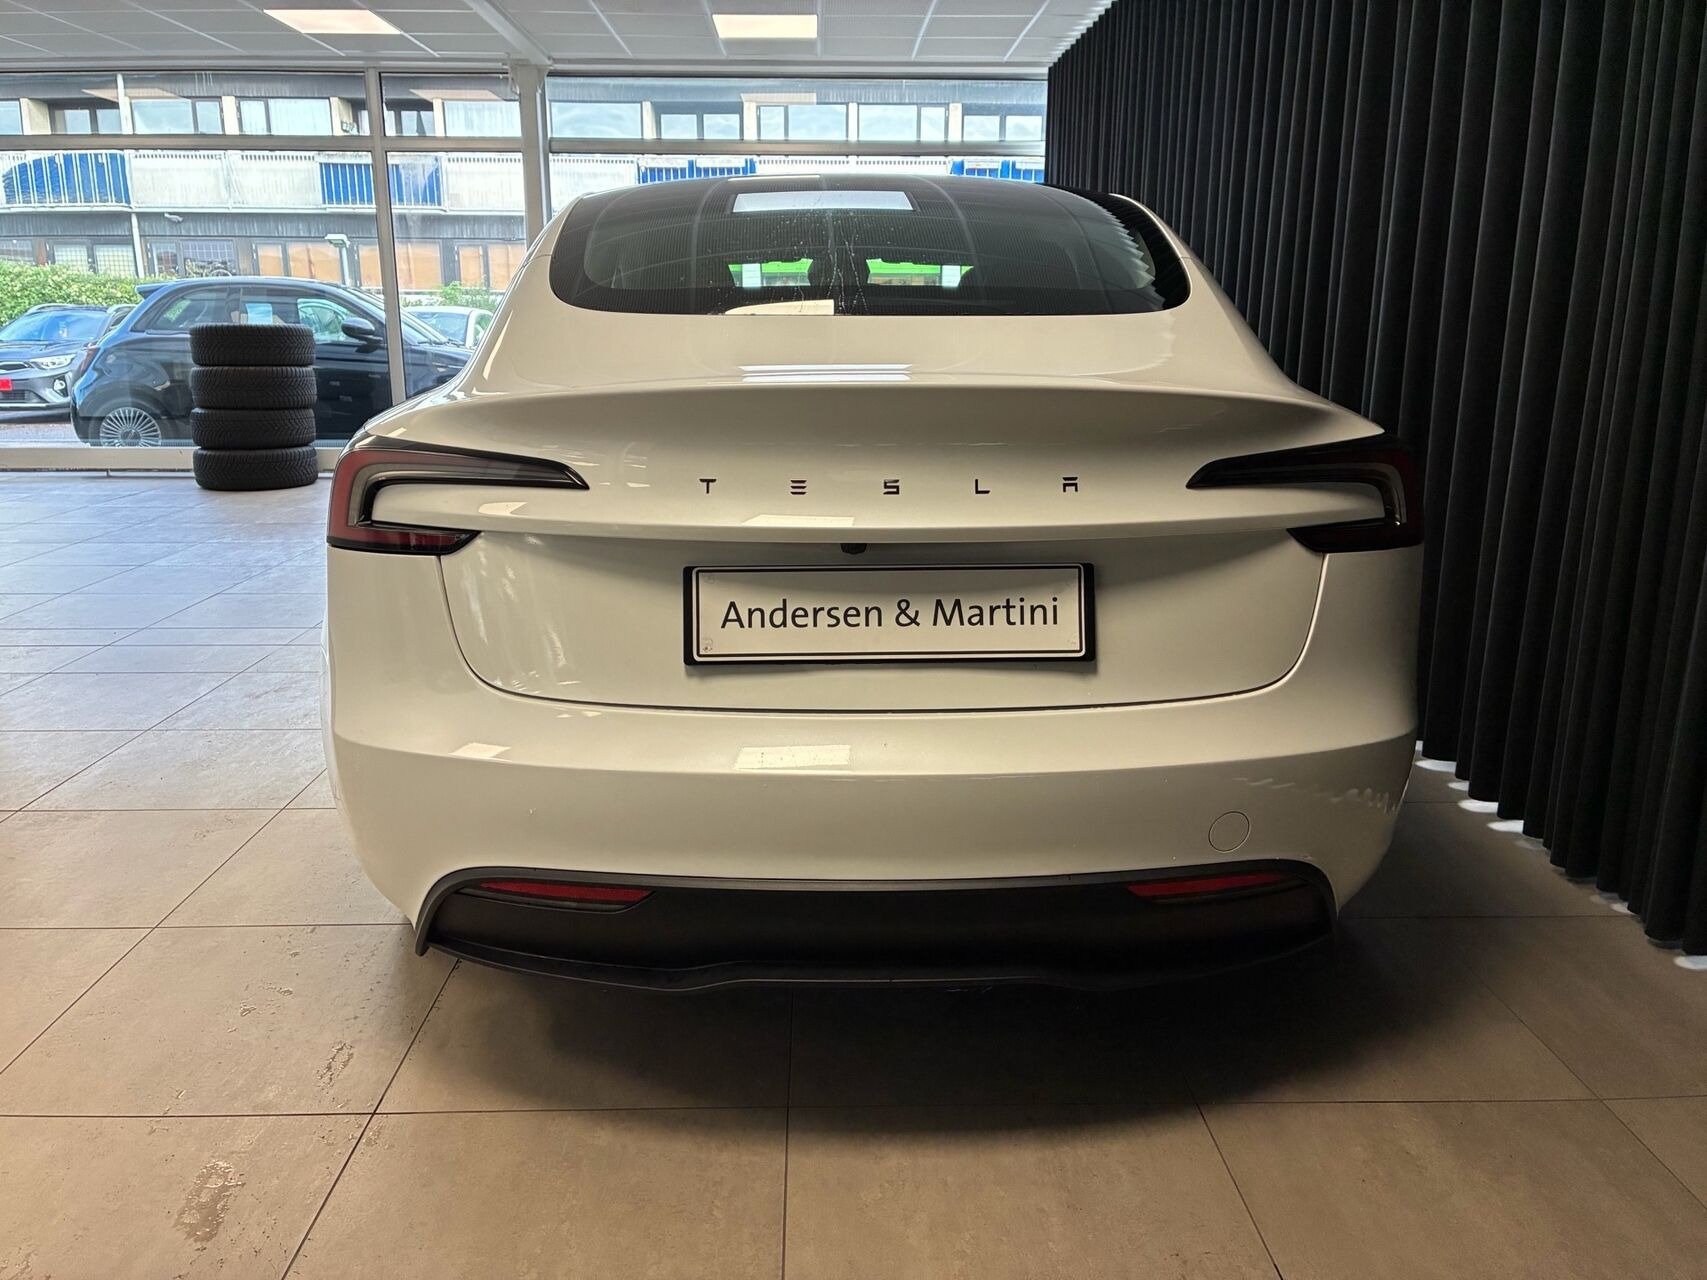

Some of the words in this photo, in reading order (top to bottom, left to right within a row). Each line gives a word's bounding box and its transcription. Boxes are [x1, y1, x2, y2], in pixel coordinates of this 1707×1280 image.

[699, 477, 1079, 495] TESLA
[720, 598, 882, 629] Andersen
[895, 598, 921, 627] &
[932, 596, 1059, 627] Martini
